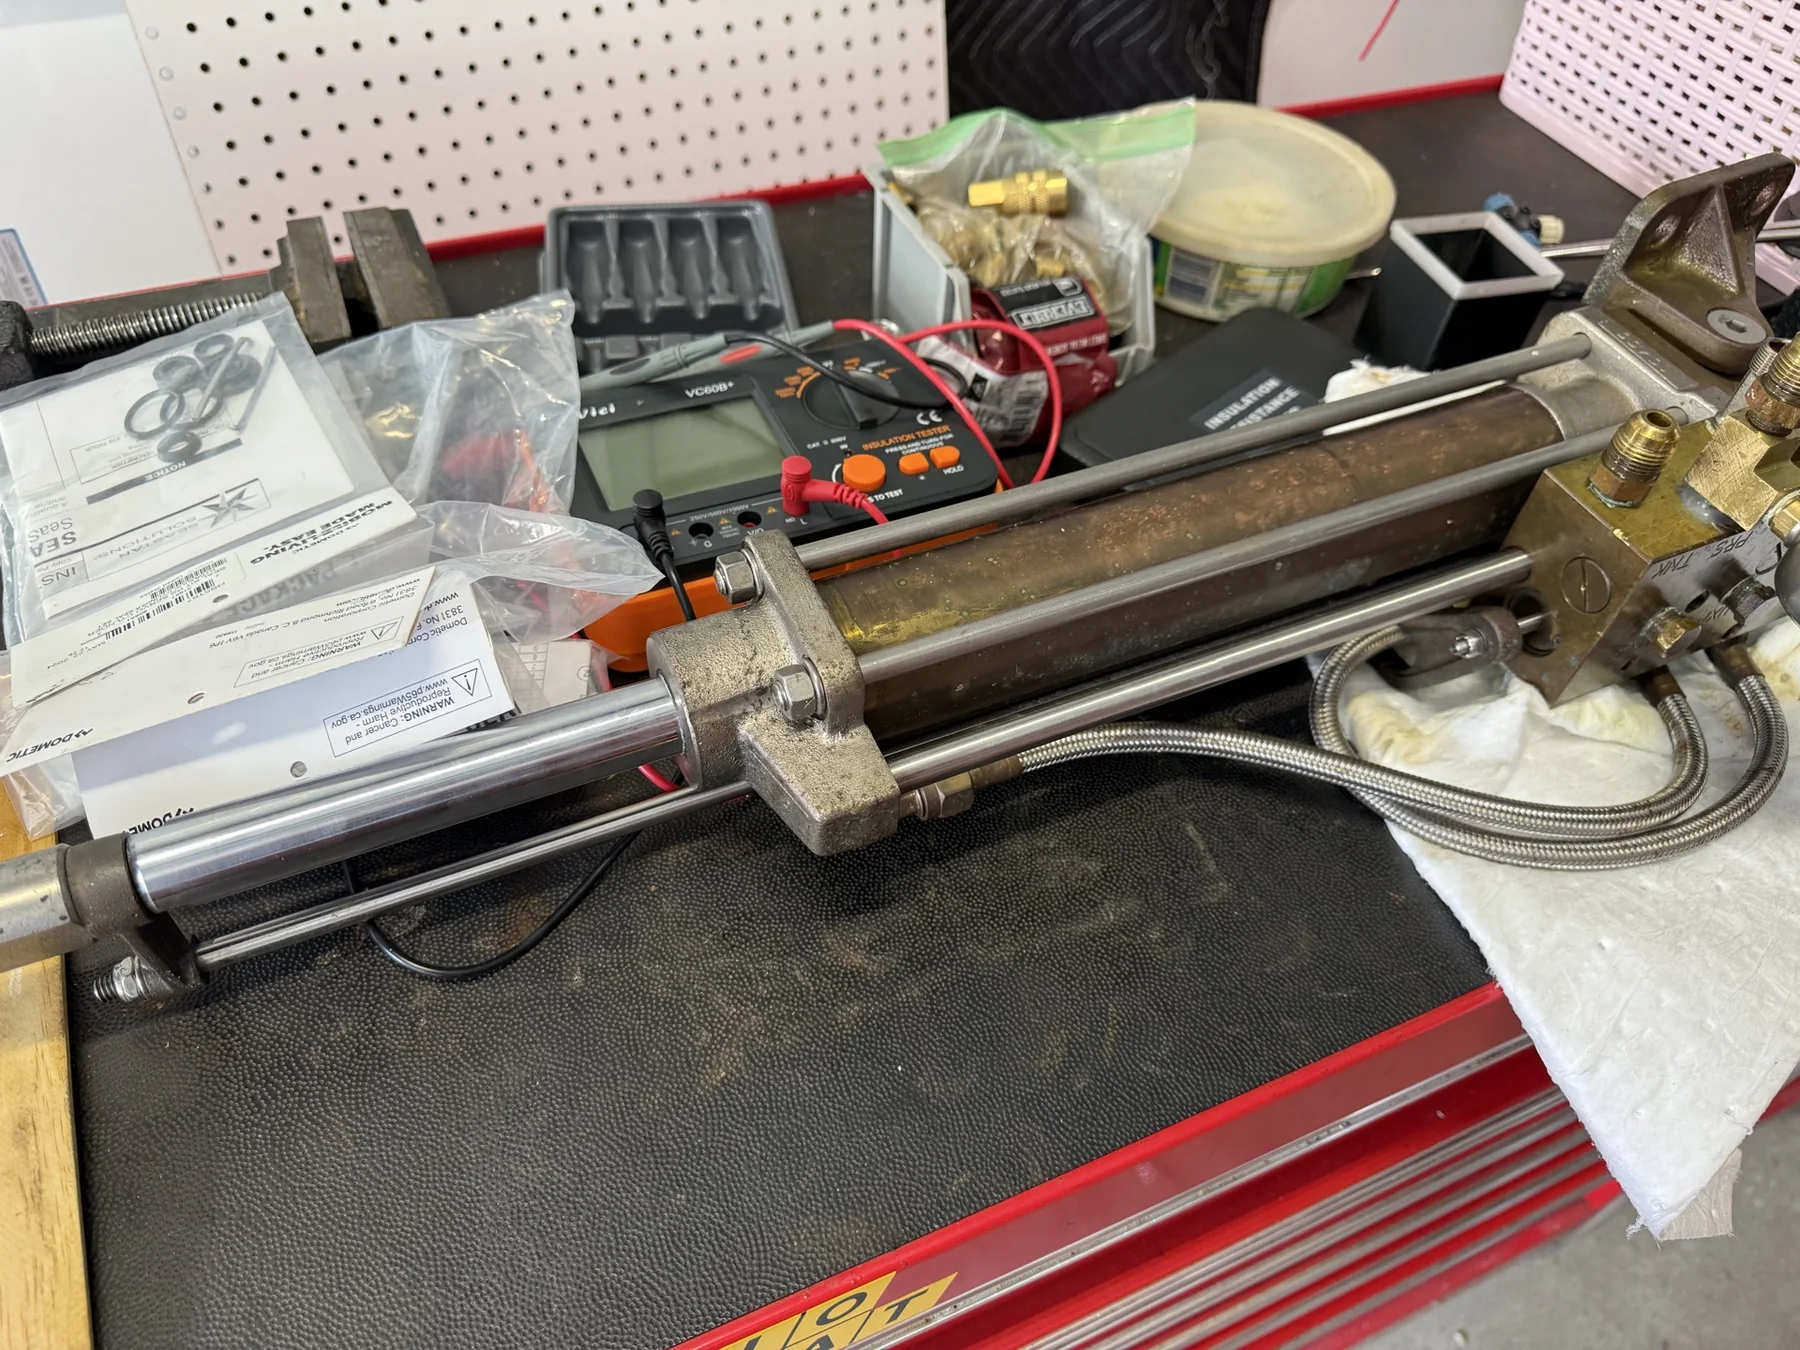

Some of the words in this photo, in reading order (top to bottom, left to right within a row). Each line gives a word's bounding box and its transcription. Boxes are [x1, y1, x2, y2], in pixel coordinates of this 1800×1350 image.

[1018, 300, 1087, 327] EVERBILT
[685, 381, 734, 398] VC60B+
[1203, 376, 1281, 430] INSULATION
[862, 433, 915, 450] INSULATION
[916, 425, 951, 438] TESTER
[144, 460, 186, 481] NOTICE
[943, 465, 964, 475] HOLD
[874, 493, 885, 501] TO
[885, 489, 903, 498] TEST
[319, 501, 374, 530] MADE
[291, 529, 344, 554] DOMETIC
[704, 540, 712, 548] G
[1710, 530, 1753, 558] PRS
[1651, 552, 1694, 579] TNK
[39, 565, 76, 589] INS
[377, 590, 414, 607] Dometic
[299, 606, 343, 623] Richmond
[323, 602, 376, 623] Corporation
[422, 613, 440, 626] No.
[439, 604, 463, 620] 3831
[244, 623, 278, 637] Canada
[428, 615, 467, 638] Dometic
[307, 640, 361, 661] WARNING:
[329, 677, 448, 729] www.p65Warnings.ca.gov
[389, 687, 451, 717] Reproductive
[399, 695, 454, 723] WARNING:
[361, 710, 388, 727] Harm
[362, 716, 398, 737] Cancer
[6, 731, 74, 762] DOMETIC
[344, 730, 363, 745] and
[123, 811, 172, 835] DOME
